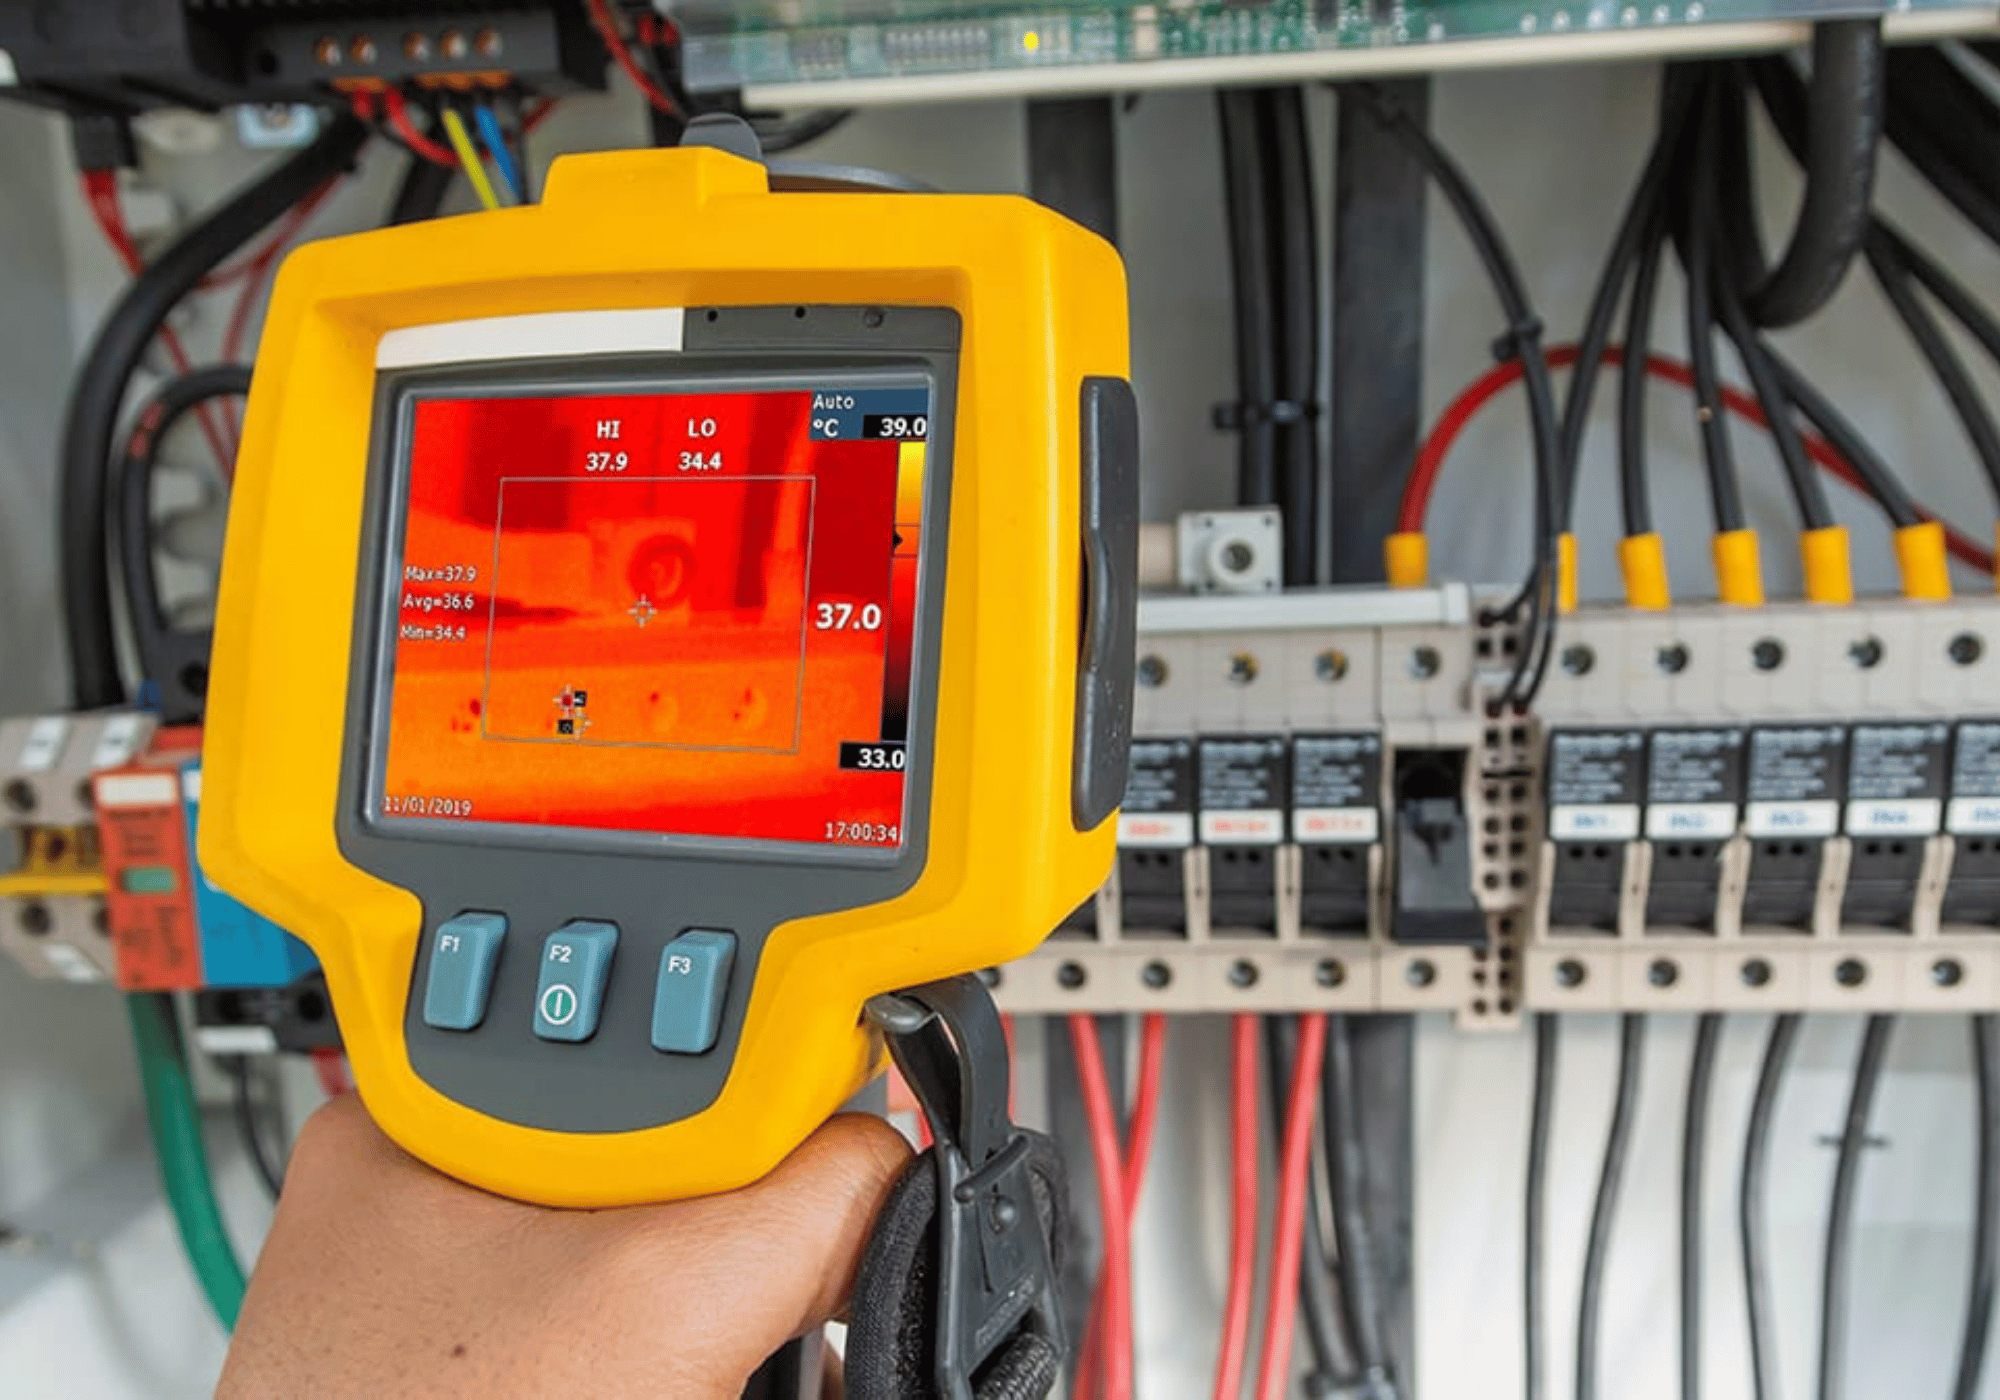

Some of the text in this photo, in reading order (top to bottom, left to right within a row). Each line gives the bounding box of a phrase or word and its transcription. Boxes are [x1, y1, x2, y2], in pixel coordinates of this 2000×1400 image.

[812, 393, 856, 411] Auto
[595, 418, 718, 440] HI LO
[879, 416, 928, 438] 39.0
[584, 451, 723, 472] 37.9 34.4
[403, 565, 477, 582] Max=37.9
[401, 592, 475, 614] Avg=36.6
[815, 602, 882, 631] 37.0
[399, 624, 466, 641] Min=34.4
[857, 748, 907, 770] 33.0
[383, 795, 473, 817] 11/01/2019
[825, 821, 898, 843] 17:00:34
[439, 934, 461, 954] F1
[549, 944, 572, 964] F2
[667, 955, 693, 975] F3
